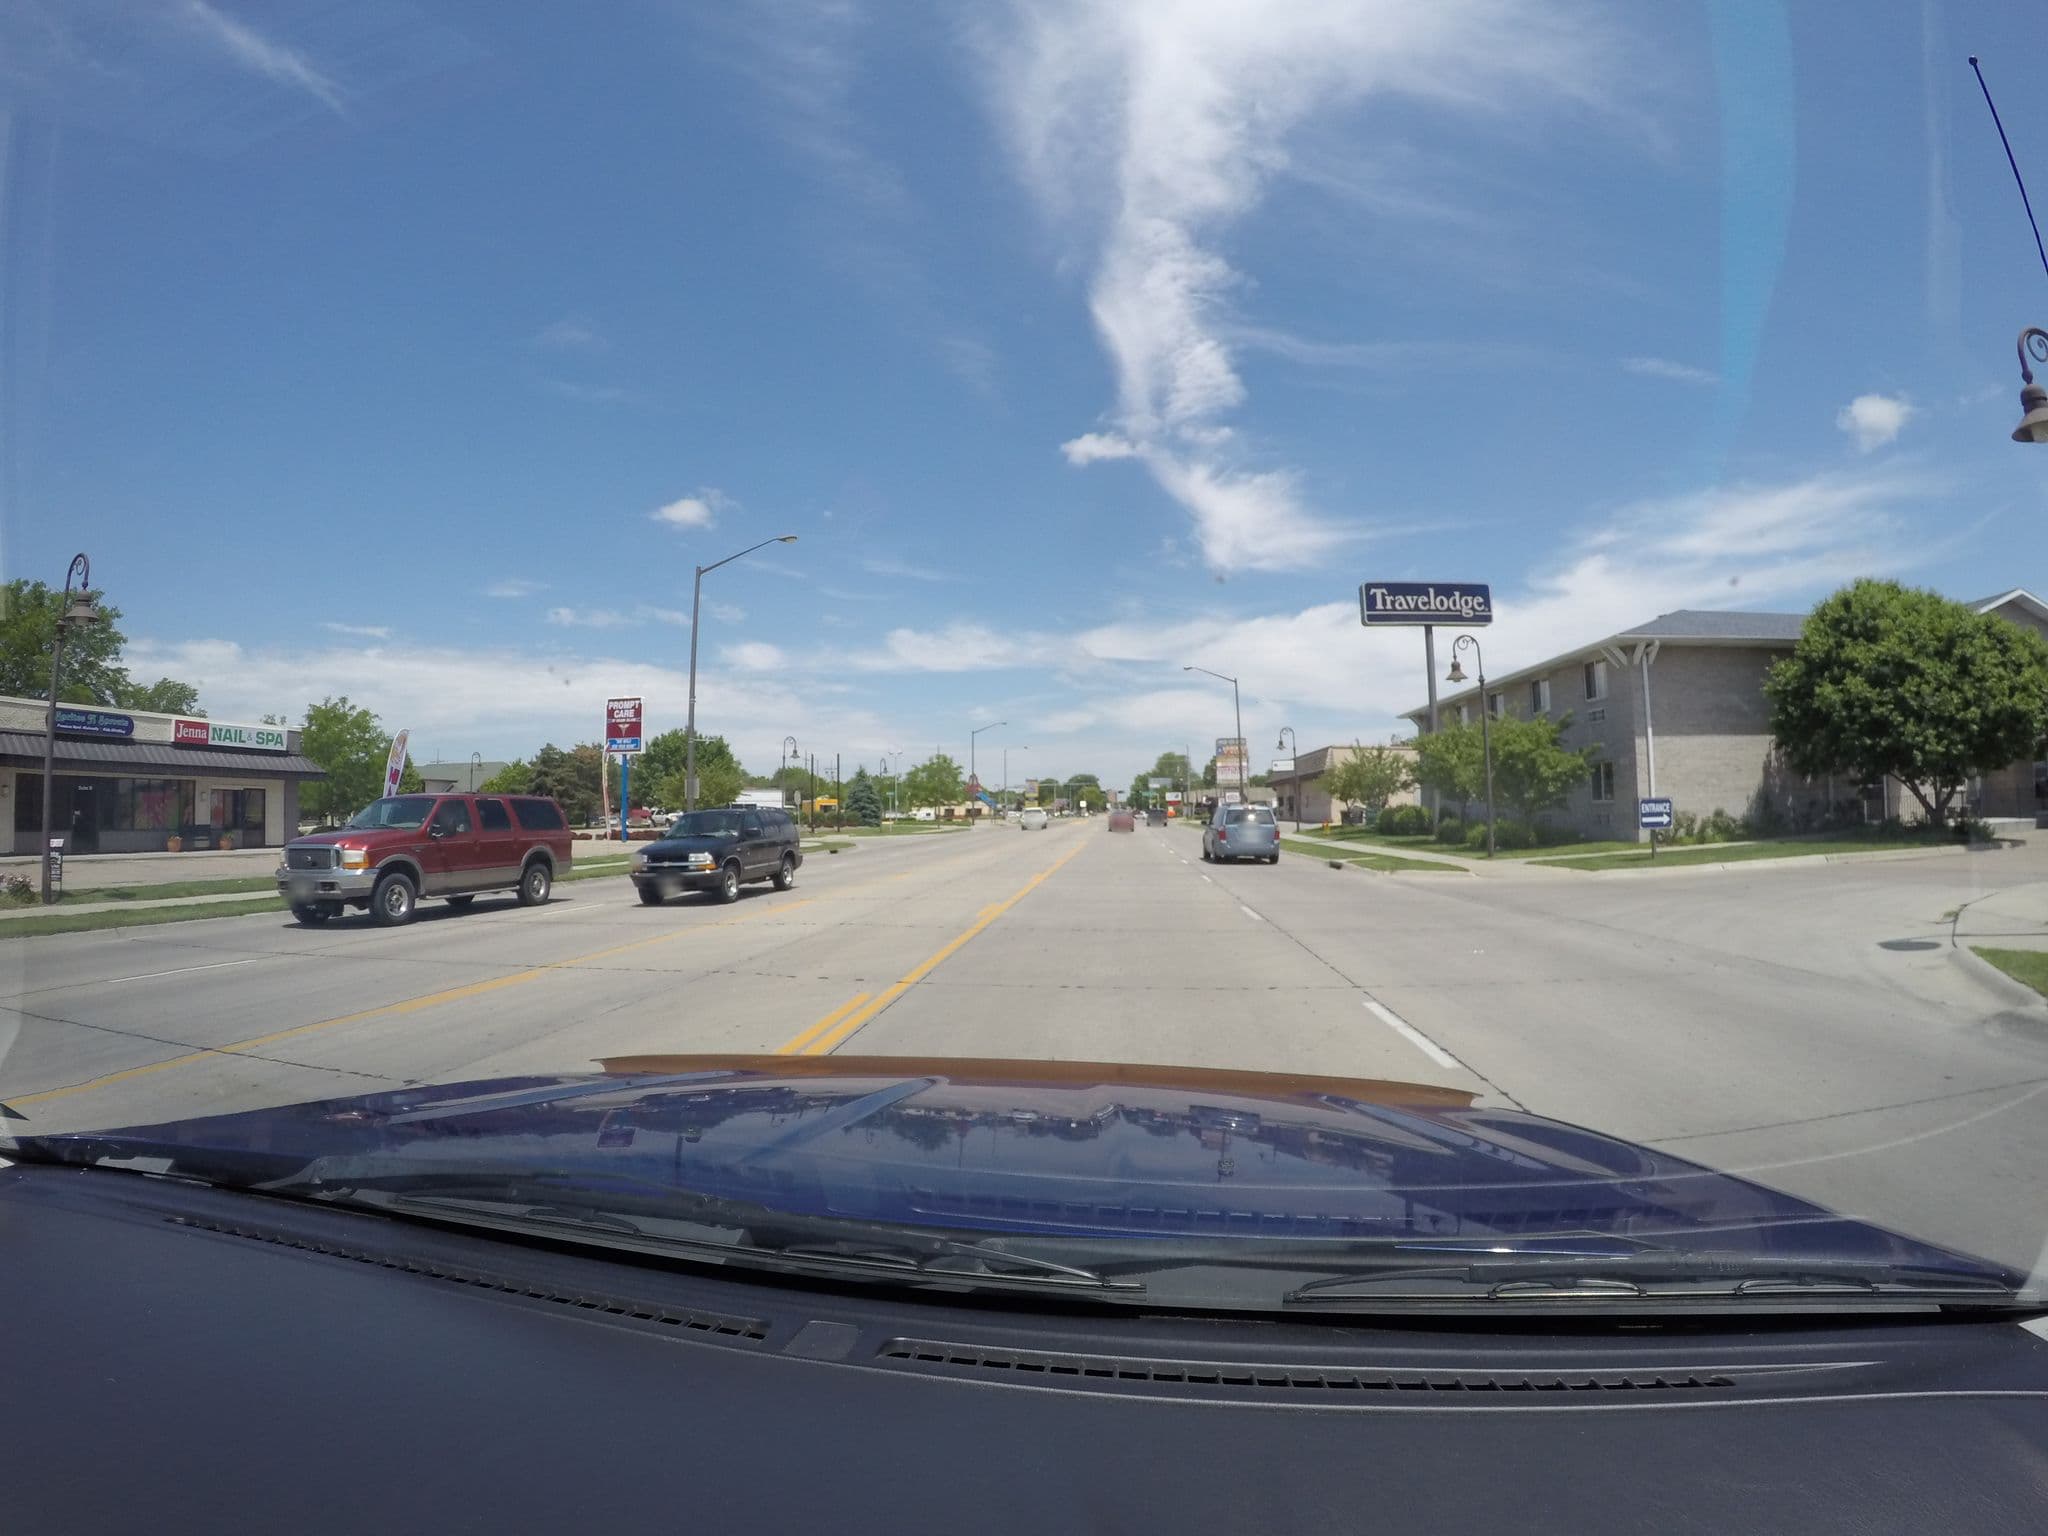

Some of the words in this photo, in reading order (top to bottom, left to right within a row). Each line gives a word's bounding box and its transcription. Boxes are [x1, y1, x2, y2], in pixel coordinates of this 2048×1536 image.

[1369, 587, 1485, 617] Travelodge
[608, 700, 640, 710] PROMPT
[613, 709, 635, 719] CARE
[176, 723, 207, 739] Jenna
[211, 727, 246, 743] NAIL
[246, 732, 253, 741] &
[255, 731, 284, 746] SPA
[1641, 802, 1670, 813] ENTRANCE
